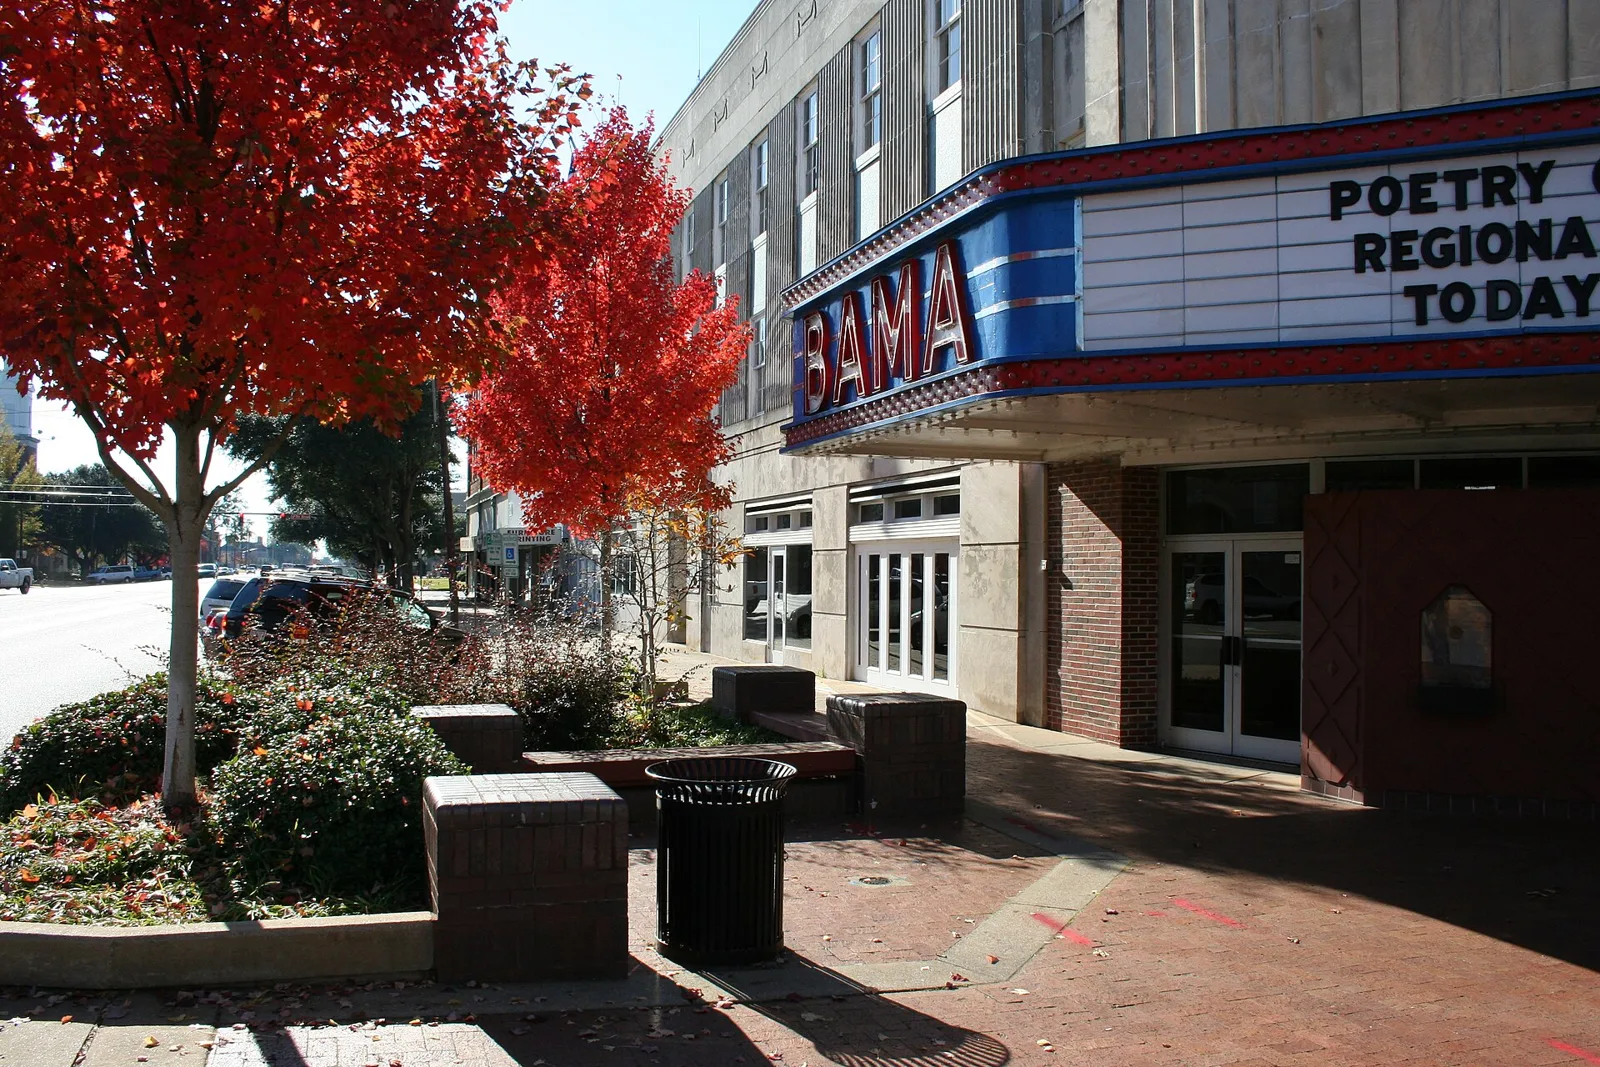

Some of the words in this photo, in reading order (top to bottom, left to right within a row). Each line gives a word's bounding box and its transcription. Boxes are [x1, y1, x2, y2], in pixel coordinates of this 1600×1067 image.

[1329, 160, 1556, 221] POETRY
[1354, 215, 1598, 274] REGIONA
[803, 239, 973, 415] BAMA
[1403, 274, 1600, 326] TODAY
